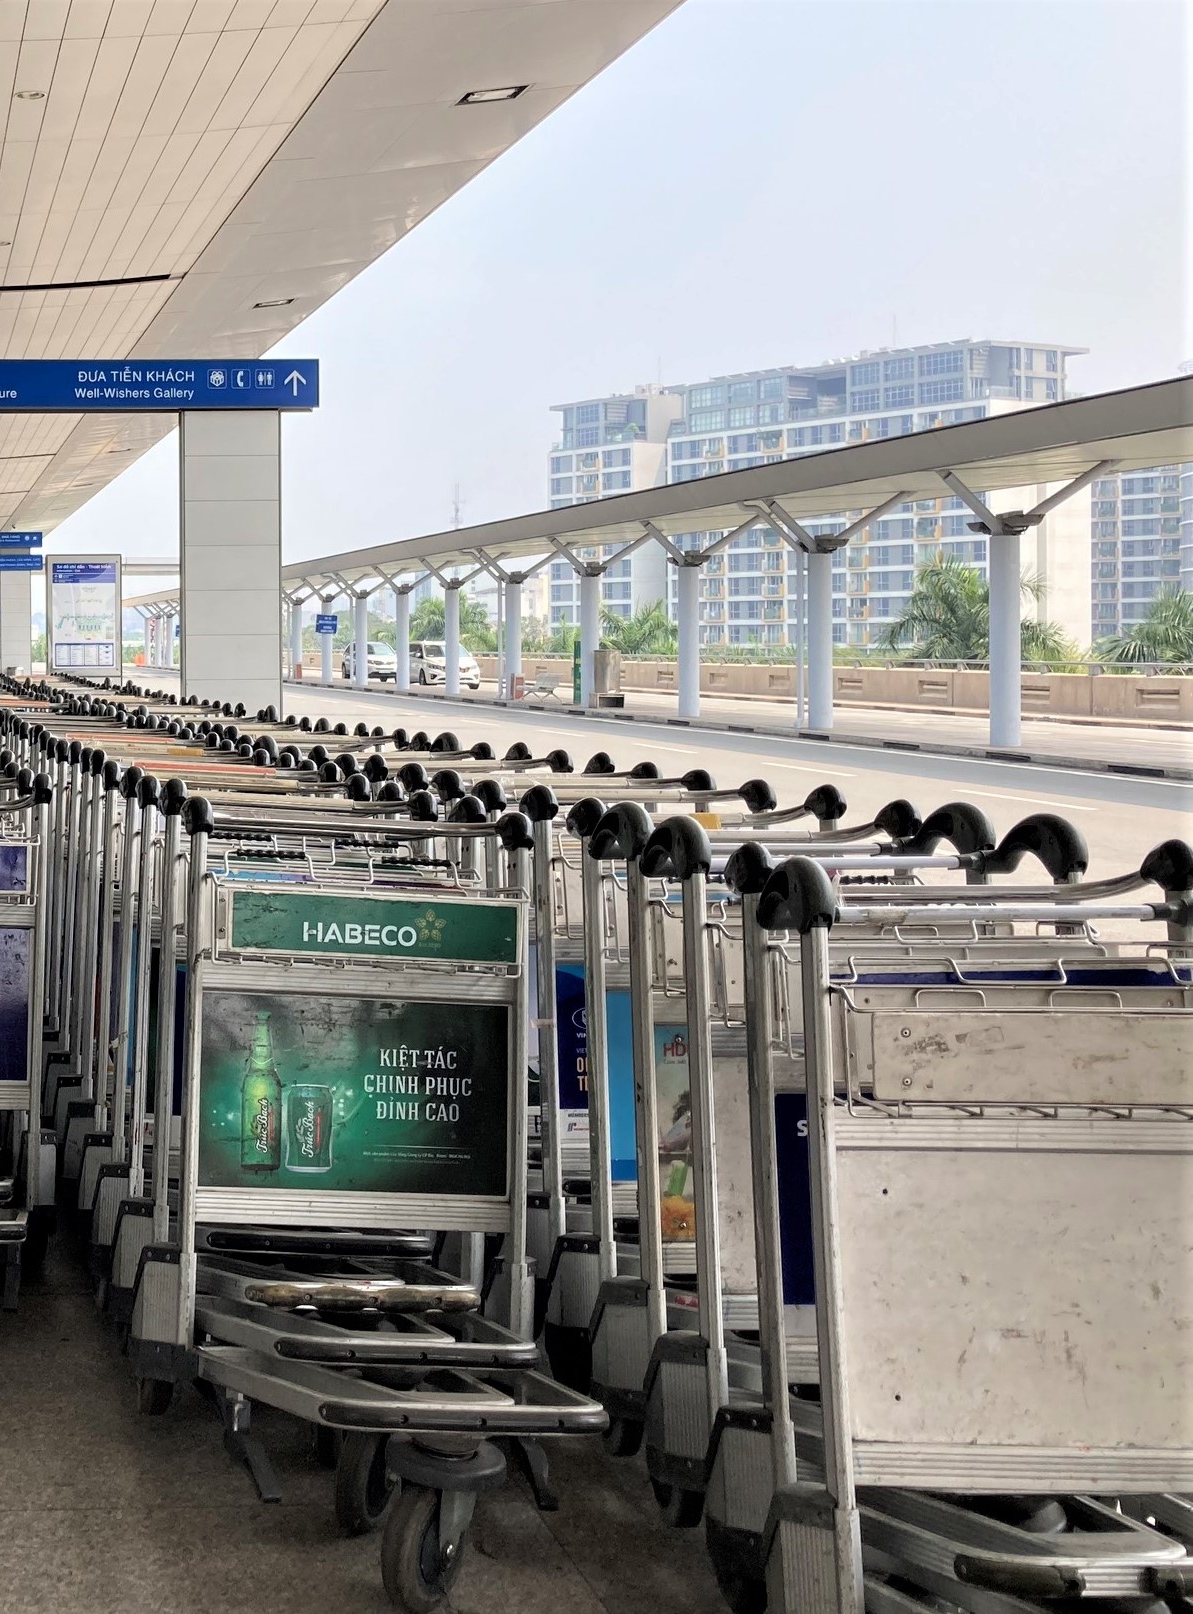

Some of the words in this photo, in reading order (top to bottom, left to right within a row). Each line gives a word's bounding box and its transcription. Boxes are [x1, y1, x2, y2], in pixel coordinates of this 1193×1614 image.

[78, 370, 107, 382] ĐƯA
[110, 366, 142, 382] TIỄN
[146, 368, 195, 382] KHÁCH
[74, 387, 150, 399] Well-Wishers
[153, 387, 195, 400] Gallery
[302, 921, 417, 947] HABECO
[379, 1044, 420, 1071] KIỆT
[424, 1046, 457, 1069] TÁC
[425, 1077, 472, 1100] PHỤC
[376, 1097, 420, 1121] ĐỈNH
[425, 1102, 460, 1122] CAO
